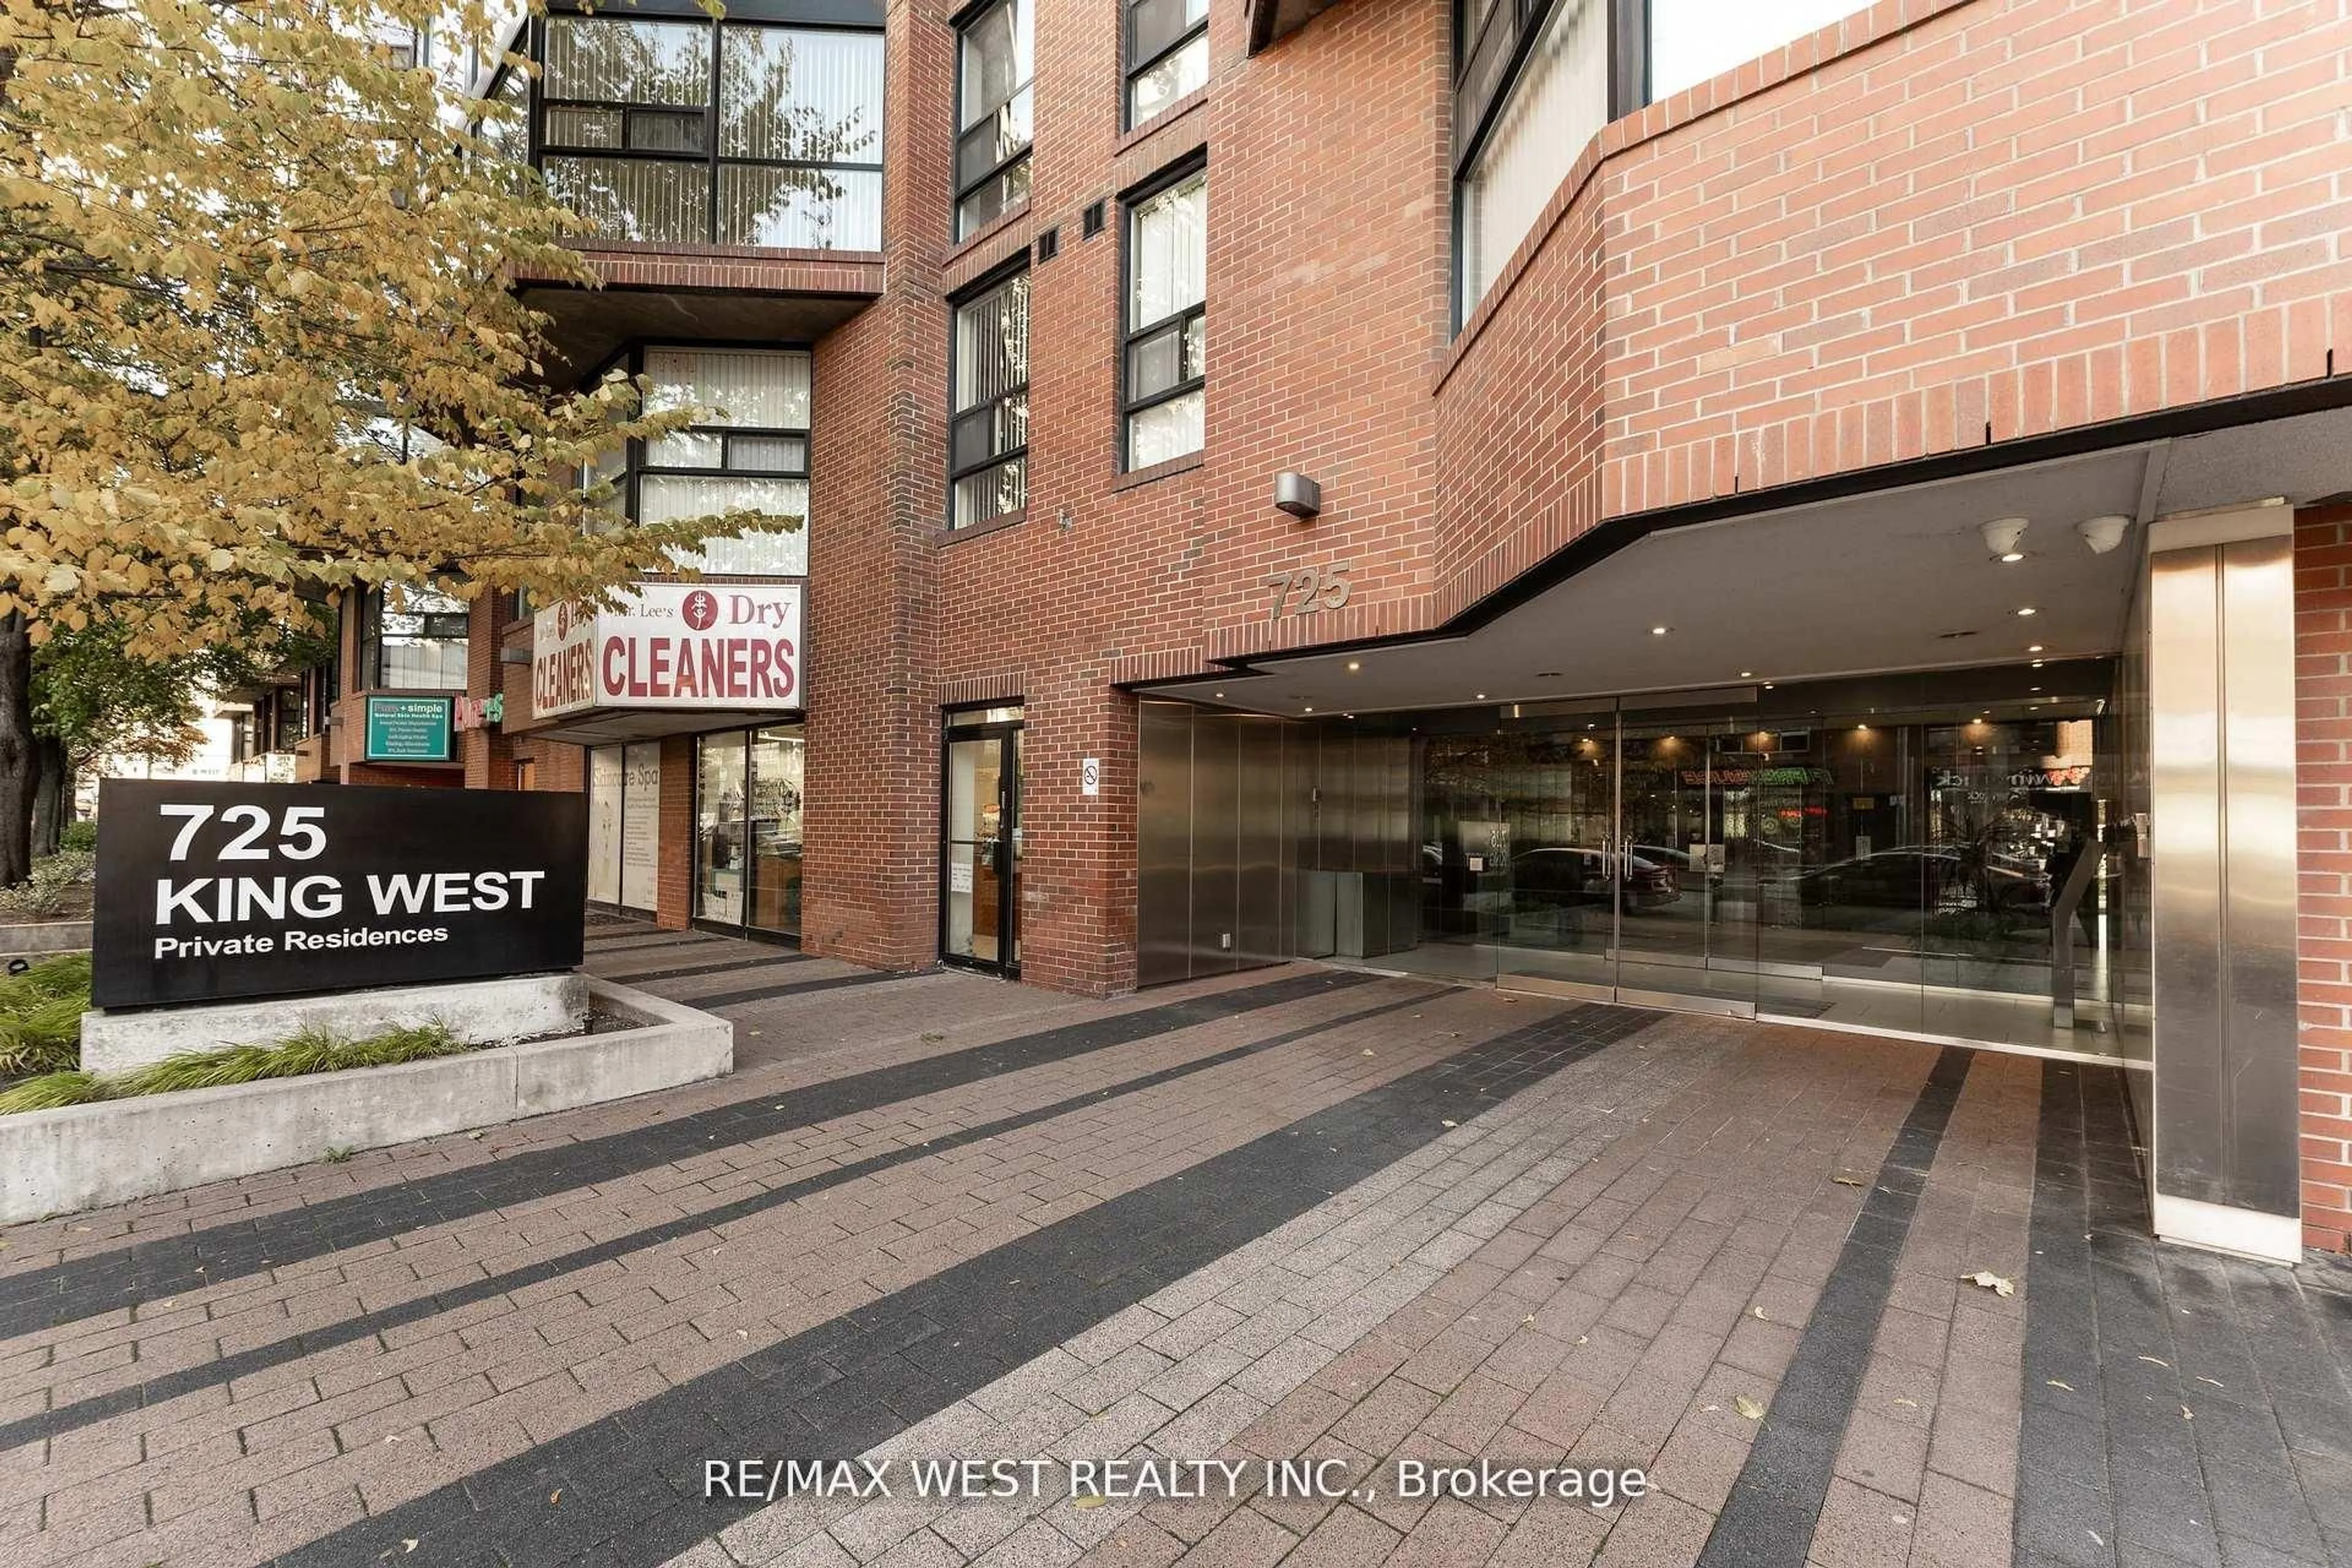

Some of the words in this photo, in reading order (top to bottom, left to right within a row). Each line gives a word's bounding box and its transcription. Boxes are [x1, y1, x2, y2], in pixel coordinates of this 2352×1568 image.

[641, 604, 674, 617] Lee's
[728, 595, 791, 628] Dry
[1267, 562, 1351, 619] 725
[537, 638, 594, 709] CLEANERS
[603, 636, 794, 698] CLEANERS
[408, 703, 442, 714] simple
[638, 763, 658, 791] Spa
[160, 804, 326, 861] 725
[156, 875, 342, 925] KING
[367, 870, 545, 915] WEST
[155, 933, 274, 959] Private
[285, 926, 448, 951] Residences
